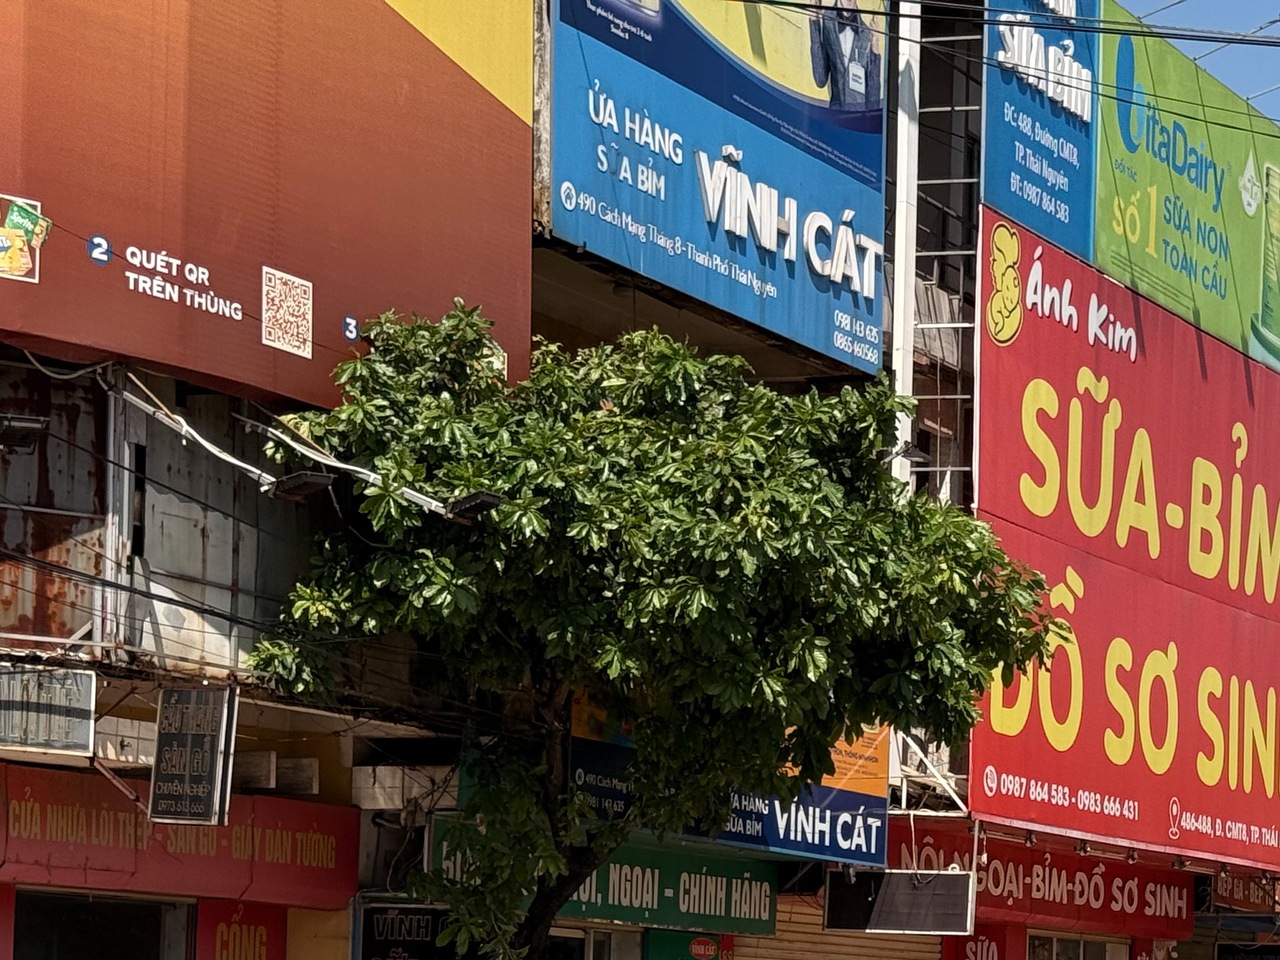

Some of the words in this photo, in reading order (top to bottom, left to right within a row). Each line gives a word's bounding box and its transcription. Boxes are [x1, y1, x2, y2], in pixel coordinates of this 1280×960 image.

[625, 109, 683, 165] HÀNG
[1017, 112, 1034, 141] 488,
[637, 157, 665, 201] BỈM
[1014, 141, 1025, 165] TP.
[1026, 148, 1042, 175] Thái
[1042, 158, 1069, 192] Nguyên
[10, 211, 35, 231] Sprite
[694, 145, 798, 262] VĨNH
[802, 210, 884, 300] CÁT
[1022, 180, 1041, 207] 0987
[1041, 192, 1055, 215] 864
[1056, 201, 1069, 224] 583
[92, 236, 108, 261] 2
[578, 192, 596, 215] 490
[598, 203, 621, 227] Cách
[622, 212, 646, 242] Mạng
[648, 224, 674, 256] Tháng
[675, 236, 682, 254] 8
[712, 254, 728, 276] Phố
[747, 270, 777, 299] Nguyên
[1197, 217, 1229, 262] NON
[125, 246, 181, 279] QUÉT
[185, 262, 210, 287] QR
[1201, 260, 1227, 300] CẦU
[125, 271, 179, 304] TRÊN
[183, 286, 243, 322] THÙNG
[1026, 245, 1078, 332] Ánh
[1087, 292, 1137, 363] Kim
[344, 317, 358, 340] 3
[1103, 636, 1180, 775] SƠ
[191, 802, 204, 813] 666
[1001, 773, 1027, 799] 0987
[1029, 780, 1049, 803] 864
[1050, 784, 1070, 807] 583
[1077, 790, 1101, 813] 0983
[1103, 795, 1121, 818] 666
[1122, 799, 1139, 821] 431
[9, 787, 41, 840] CỬA
[265, 821, 291, 864] DÁN
[296, 822, 336, 868] TƯỜNG
[741, 793, 769, 814] HÀNG
[836, 805, 882, 854] CÁT
[745, 814, 762, 837] BỈM
[1225, 821, 1249, 845] CMT8,
[1250, 826, 1260, 844] TP.
[1261, 825, 1279, 848] THÁI
[608, 863, 660, 918] NGOẠI
[679, 866, 726, 916] CHÍNH
[731, 873, 771, 920] HÃNG
[1110, 877, 1139, 915] SƠ
[1145, 882, 1187, 920] SINH
[374, 910, 431, 940] VĨNH
